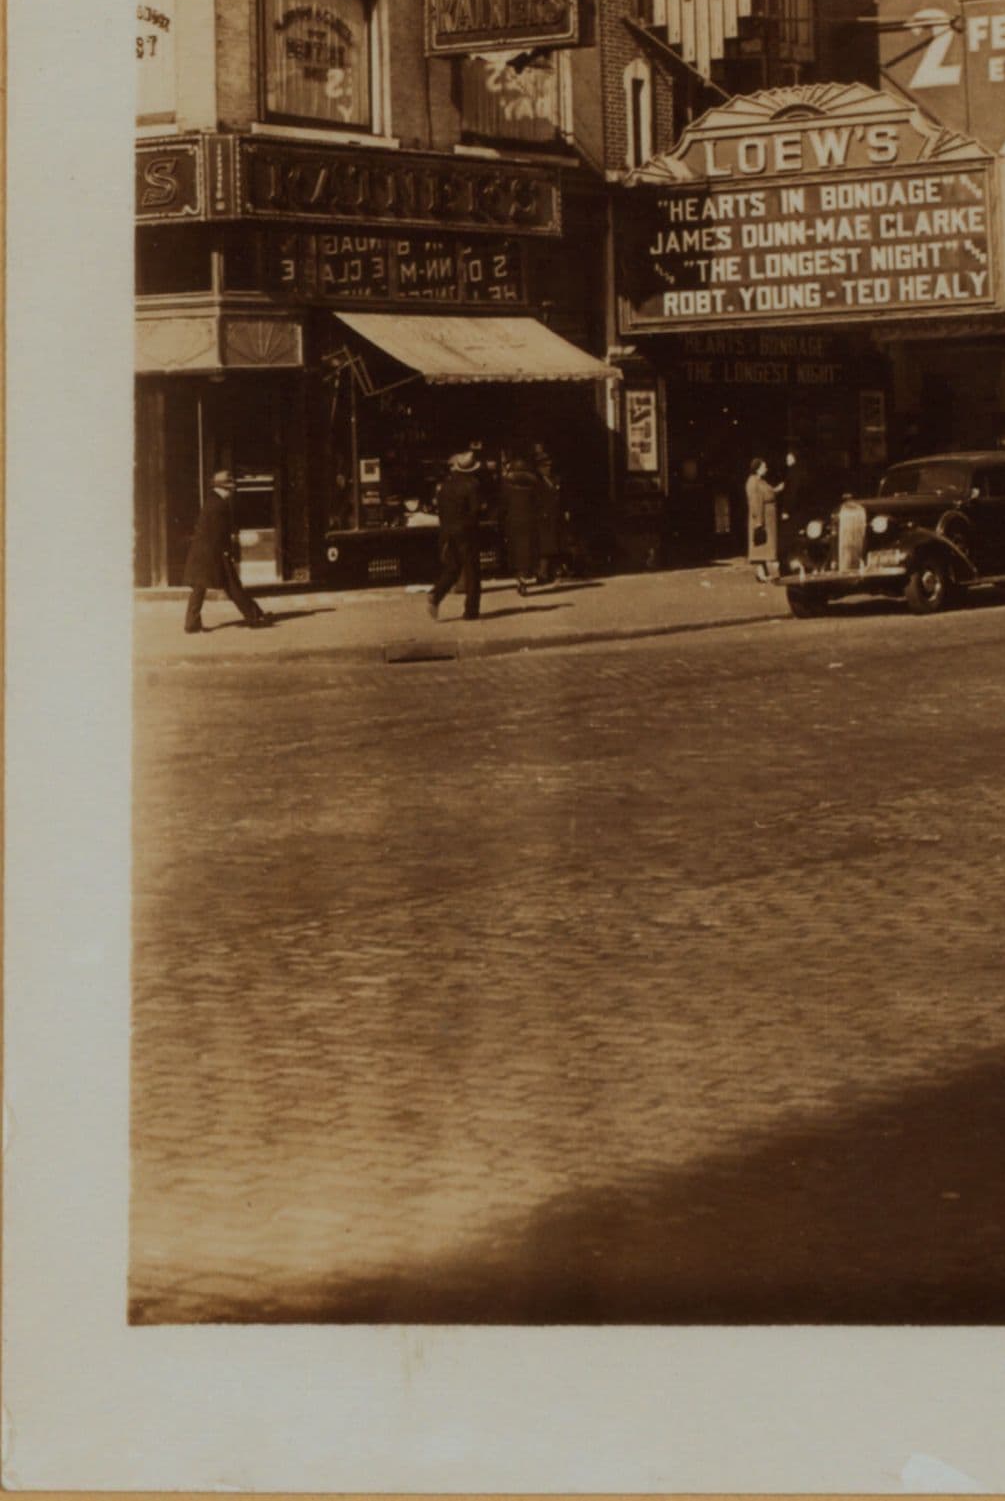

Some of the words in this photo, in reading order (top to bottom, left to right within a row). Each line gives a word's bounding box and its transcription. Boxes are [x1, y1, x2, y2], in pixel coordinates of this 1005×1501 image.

[909, 8, 962, 89] 2
[703, 125, 900, 178] LOEW'S
[657, 193, 767, 222] "HEARTS
[781, 188, 805, 215] IN
[821, 176, 957, 212] BONDAGE"
[650, 225, 732, 255] JAMES
[879, 206, 986, 239] CLARKE
[683, 254, 743, 283] "THE
[749, 247, 863, 279] LONGEST
[870, 240, 959, 271] NIGHT"
[663, 290, 735, 316] ROBT.
[740, 282, 821, 312] YOUNG
[841, 277, 892, 305] TED
[899, 270, 988, 300] HEALY
